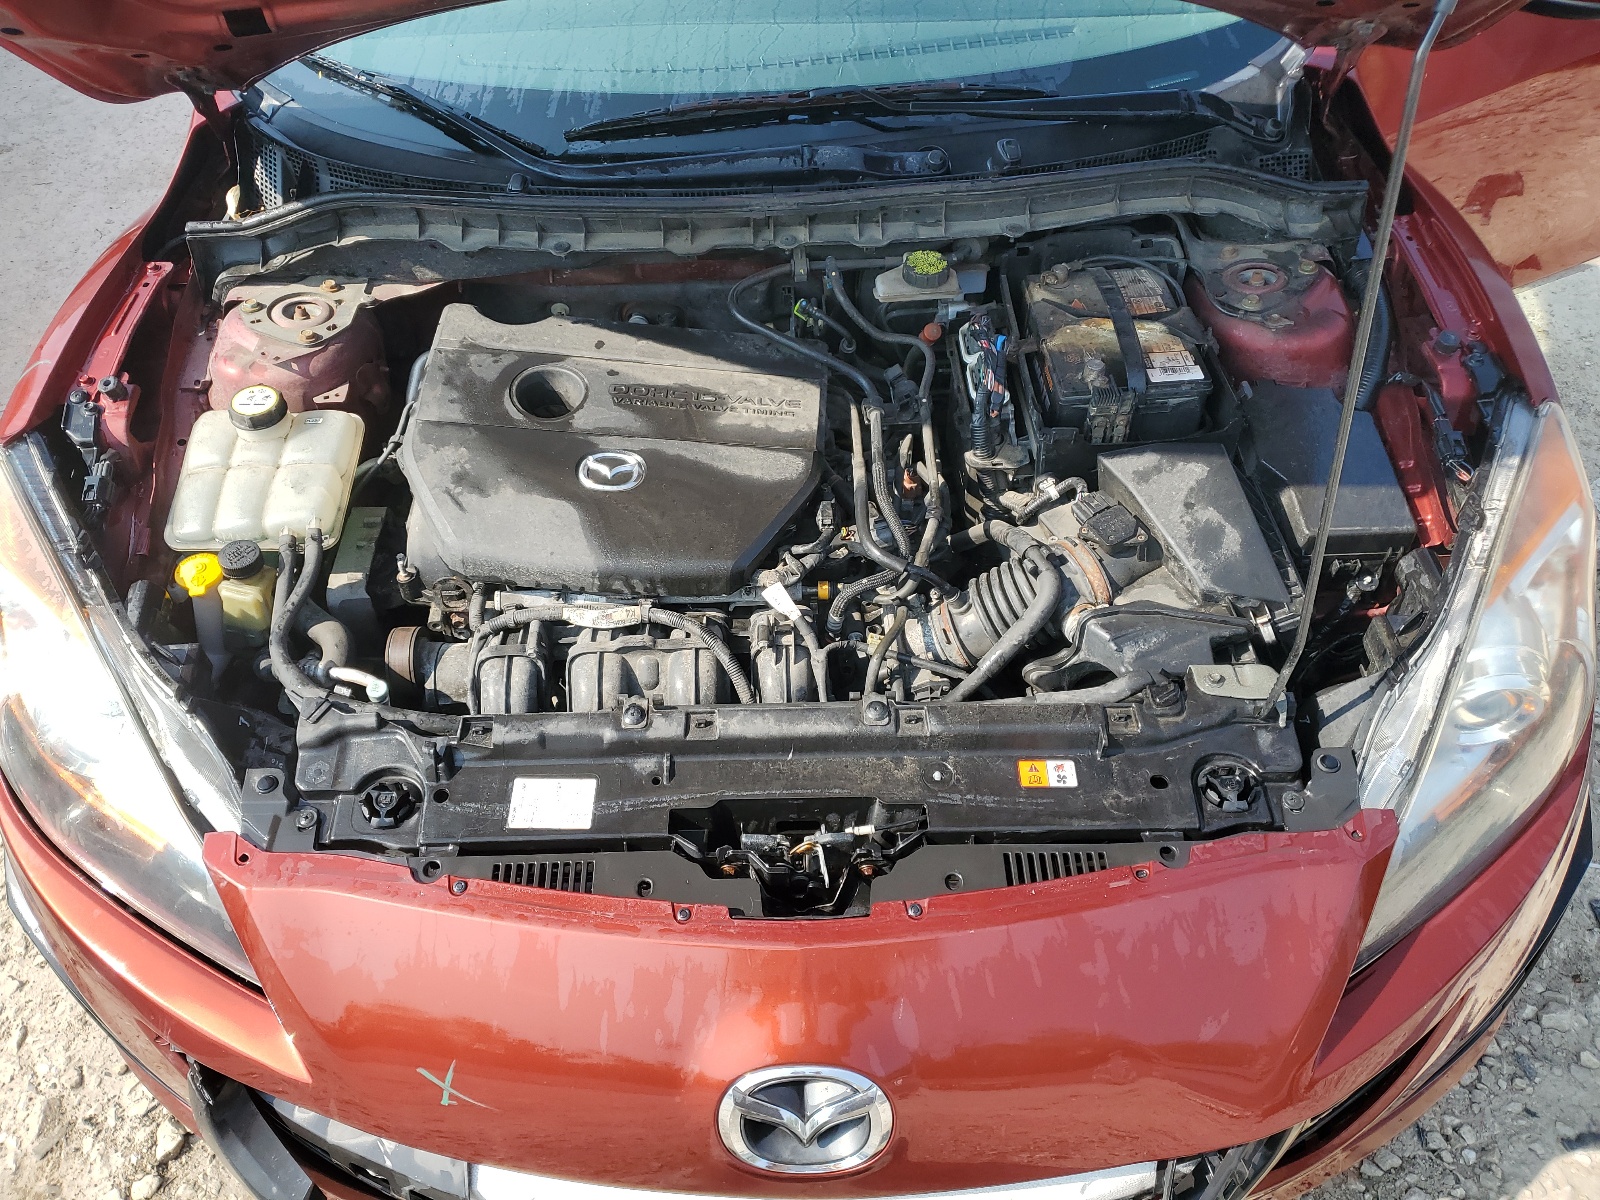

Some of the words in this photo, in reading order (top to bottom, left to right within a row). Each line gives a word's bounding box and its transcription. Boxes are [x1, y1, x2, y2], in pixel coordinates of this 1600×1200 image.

[612, 397, 689, 410] VARIABLE
[692, 403, 738, 414] VALVE
[741, 407, 796, 418] TIMING
